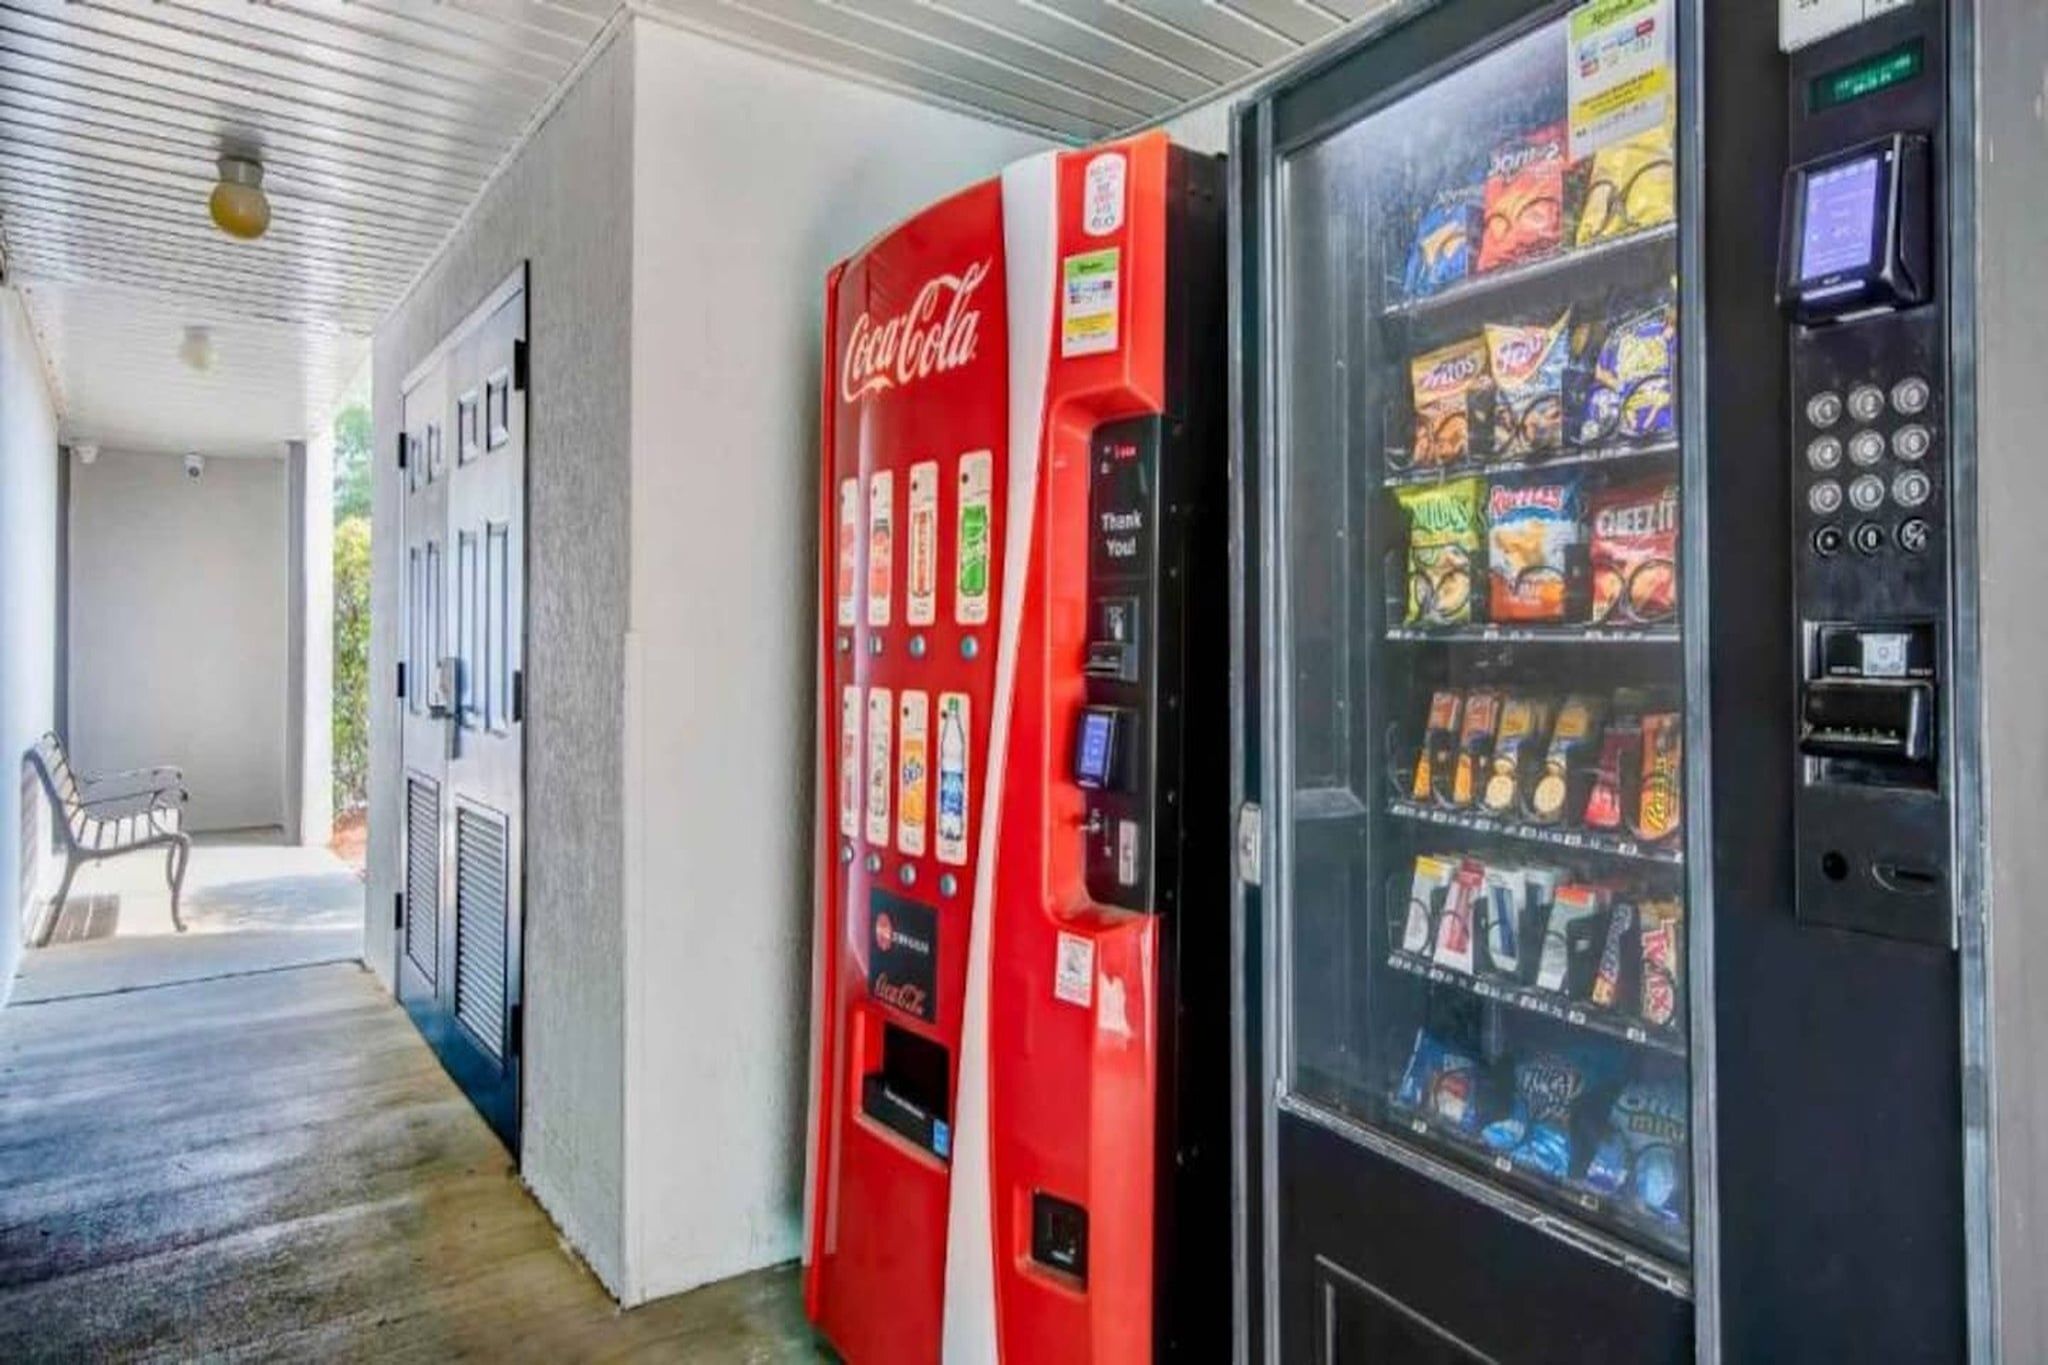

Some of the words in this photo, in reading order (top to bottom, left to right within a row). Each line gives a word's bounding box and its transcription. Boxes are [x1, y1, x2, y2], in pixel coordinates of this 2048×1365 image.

[842, 254, 993, 402] Coca-Cola
[1101, 507, 1143, 533] Thank
[1106, 535, 1137, 558] You!
